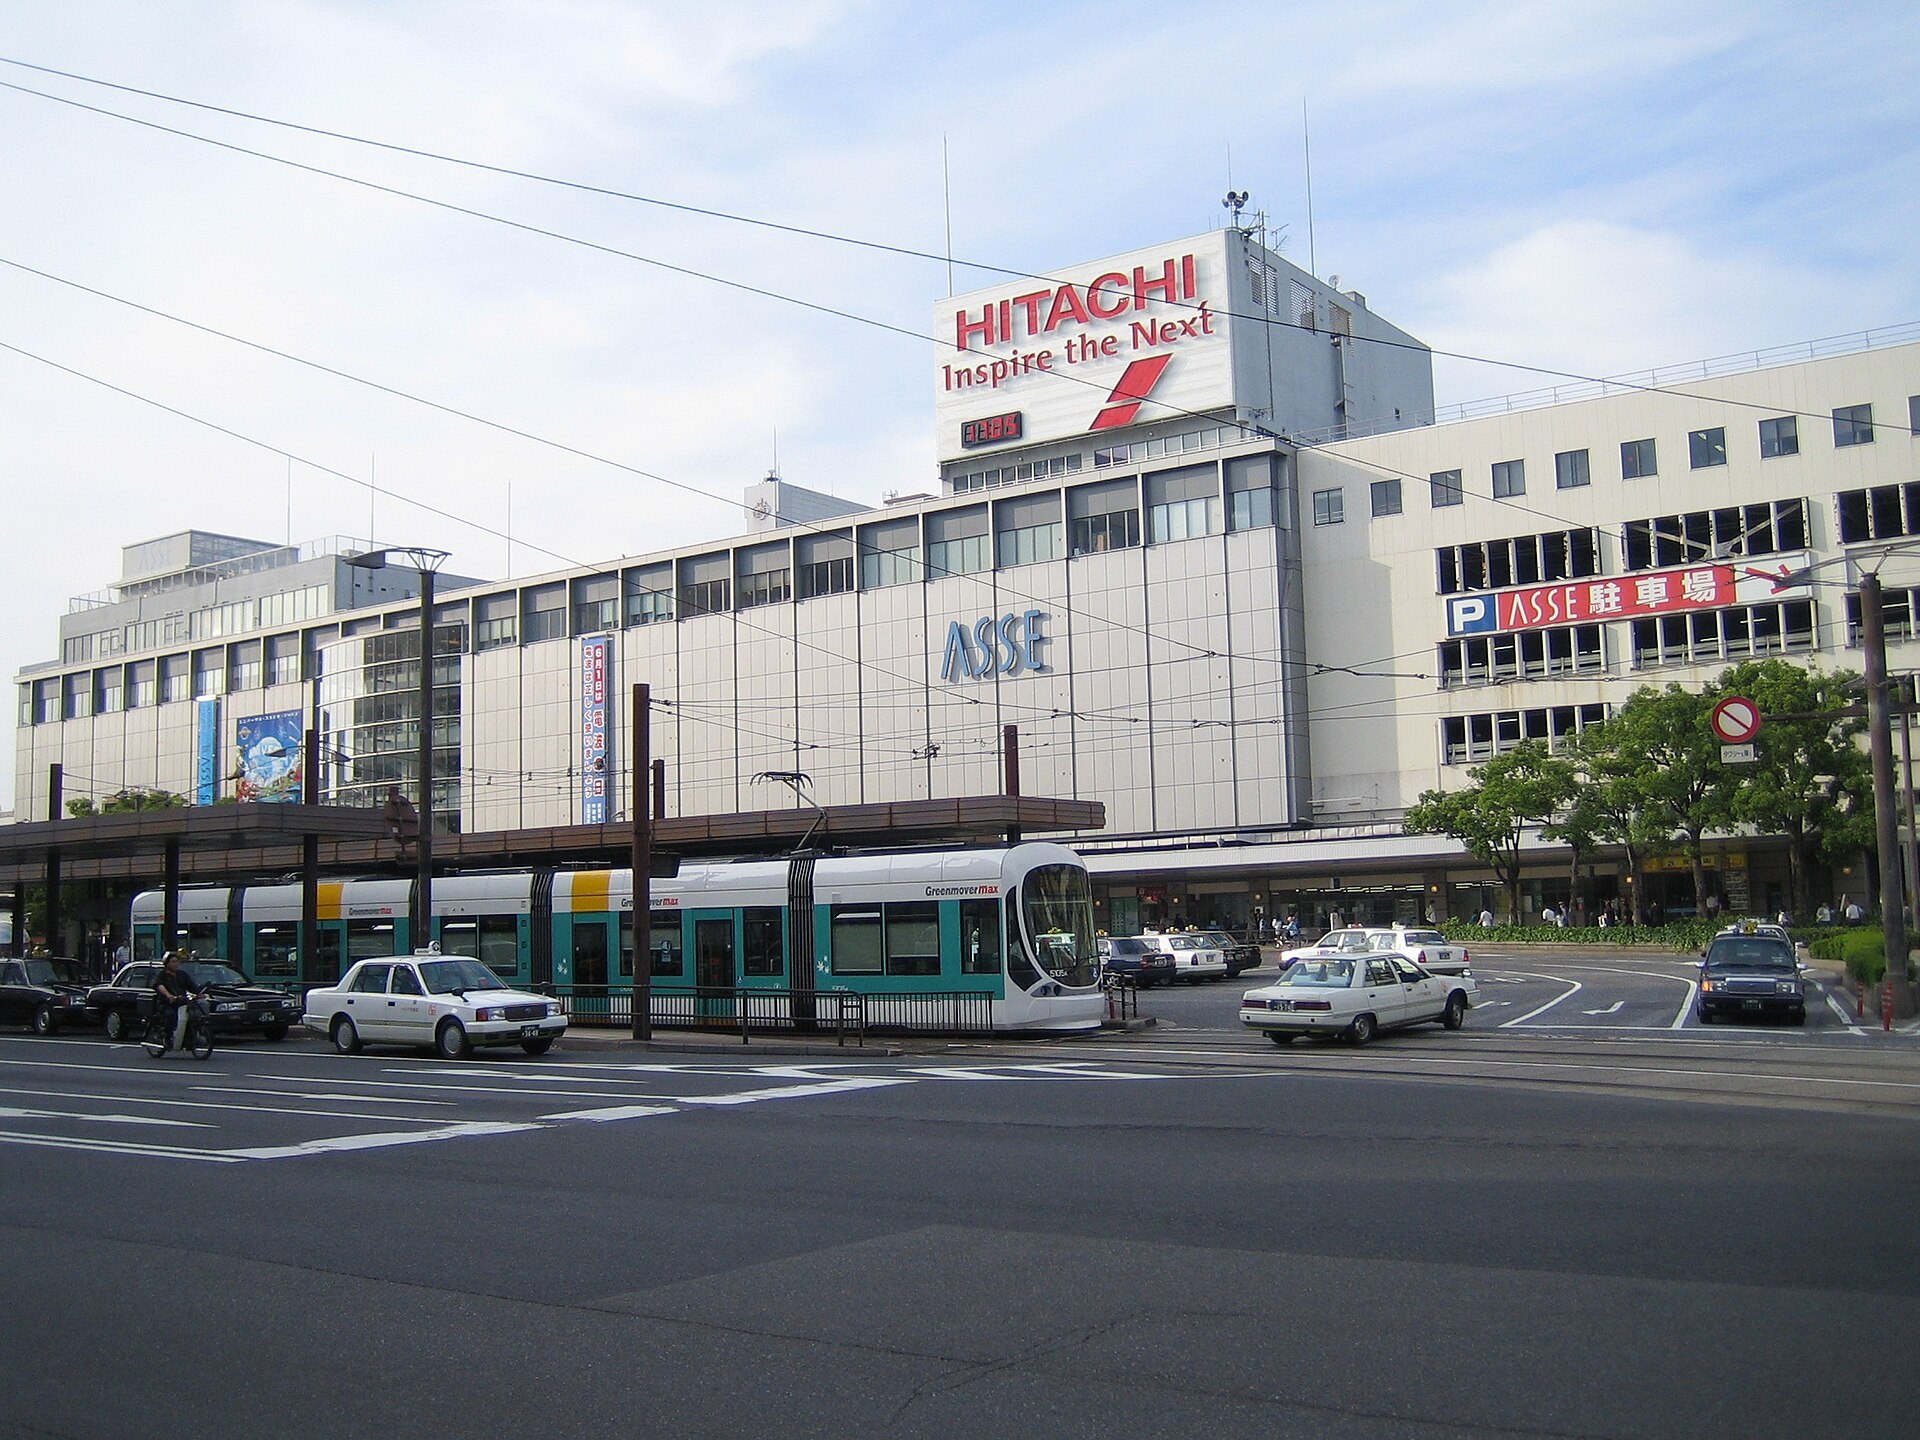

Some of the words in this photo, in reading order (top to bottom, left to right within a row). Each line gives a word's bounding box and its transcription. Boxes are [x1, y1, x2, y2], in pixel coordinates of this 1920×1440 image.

[955, 253, 1197, 353] HITACHI
[941, 349, 1053, 392] Inspire
[1064, 333, 1119, 365] the
[1129, 300, 1214, 350] Next
[1452, 598, 1486, 632] P
[1508, 585, 1579, 627] ASSE
[1587, 569, 1718, 615] 駐車場
[940, 608, 1042, 680] ASSE
[925, 885, 999, 896] Greenmovermax
